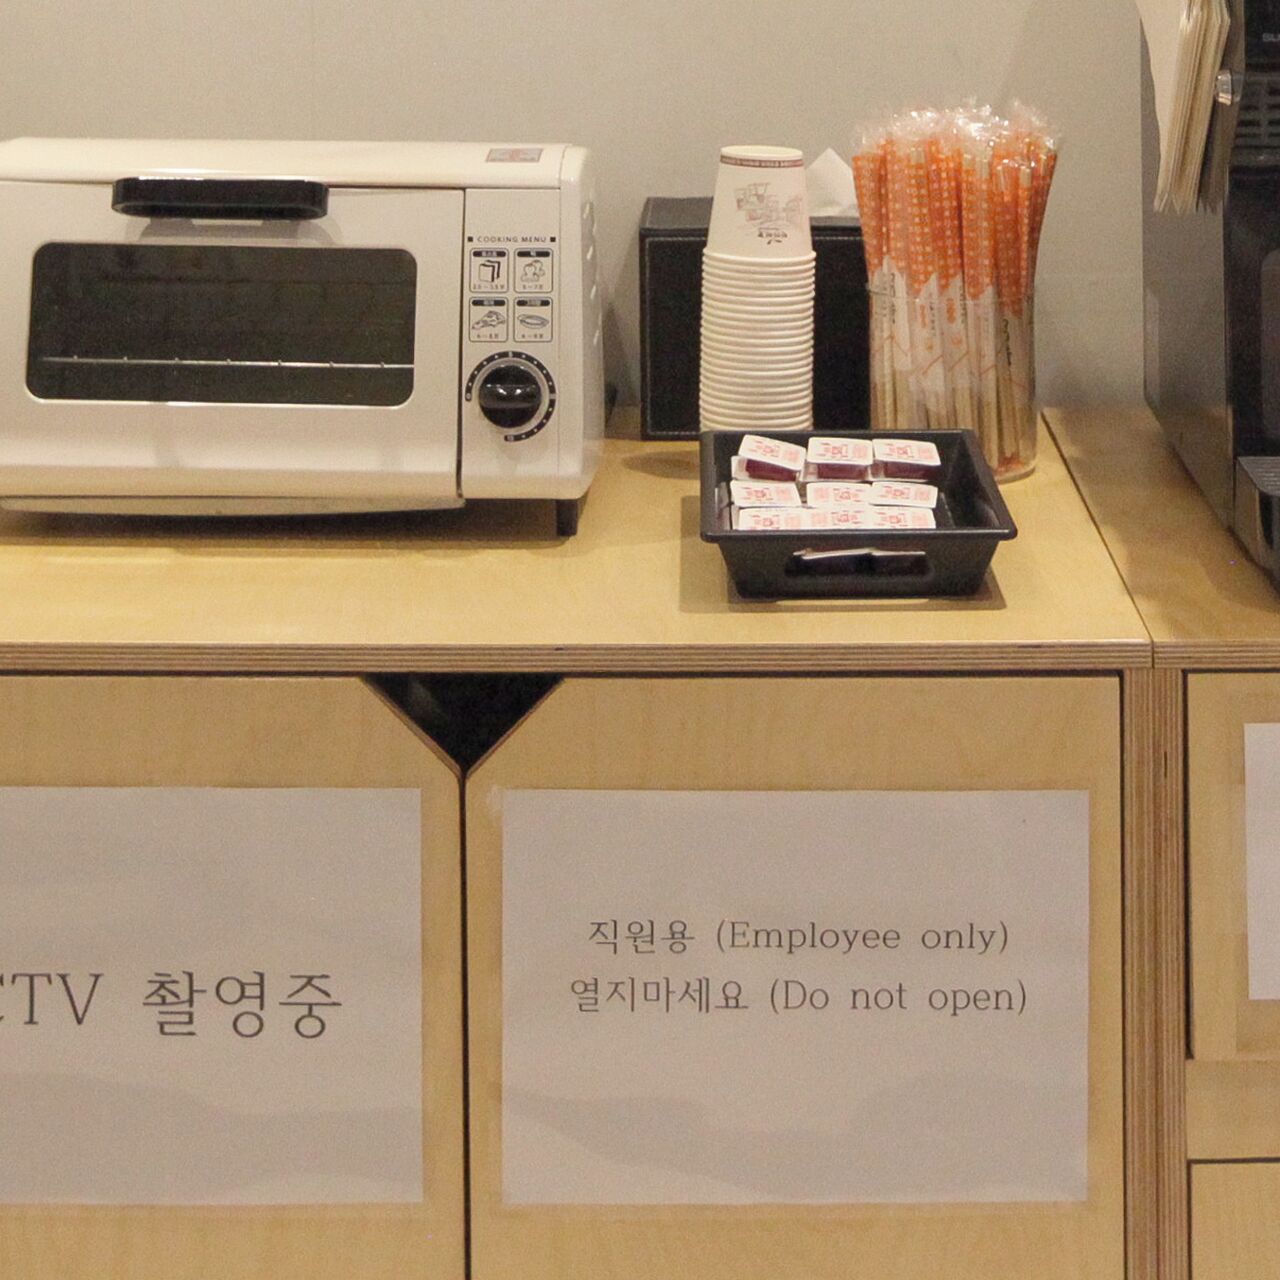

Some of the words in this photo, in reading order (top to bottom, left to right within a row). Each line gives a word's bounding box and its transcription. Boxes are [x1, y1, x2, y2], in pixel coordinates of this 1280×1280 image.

[476, 235, 519, 244] COOKING
[520, 235, 548, 244] MENU
[587, 918, 696, 956] 직원용
[715, 919, 902, 956] (Employee
[919, 919, 1010, 956] only)
[141, 969, 344, 1040] 촬영중
[569, 976, 750, 1014] 열지마세요
[769, 977, 830, 1014] (Do
[849, 980, 908, 1011] not
[927, 978, 1028, 1017] open)
